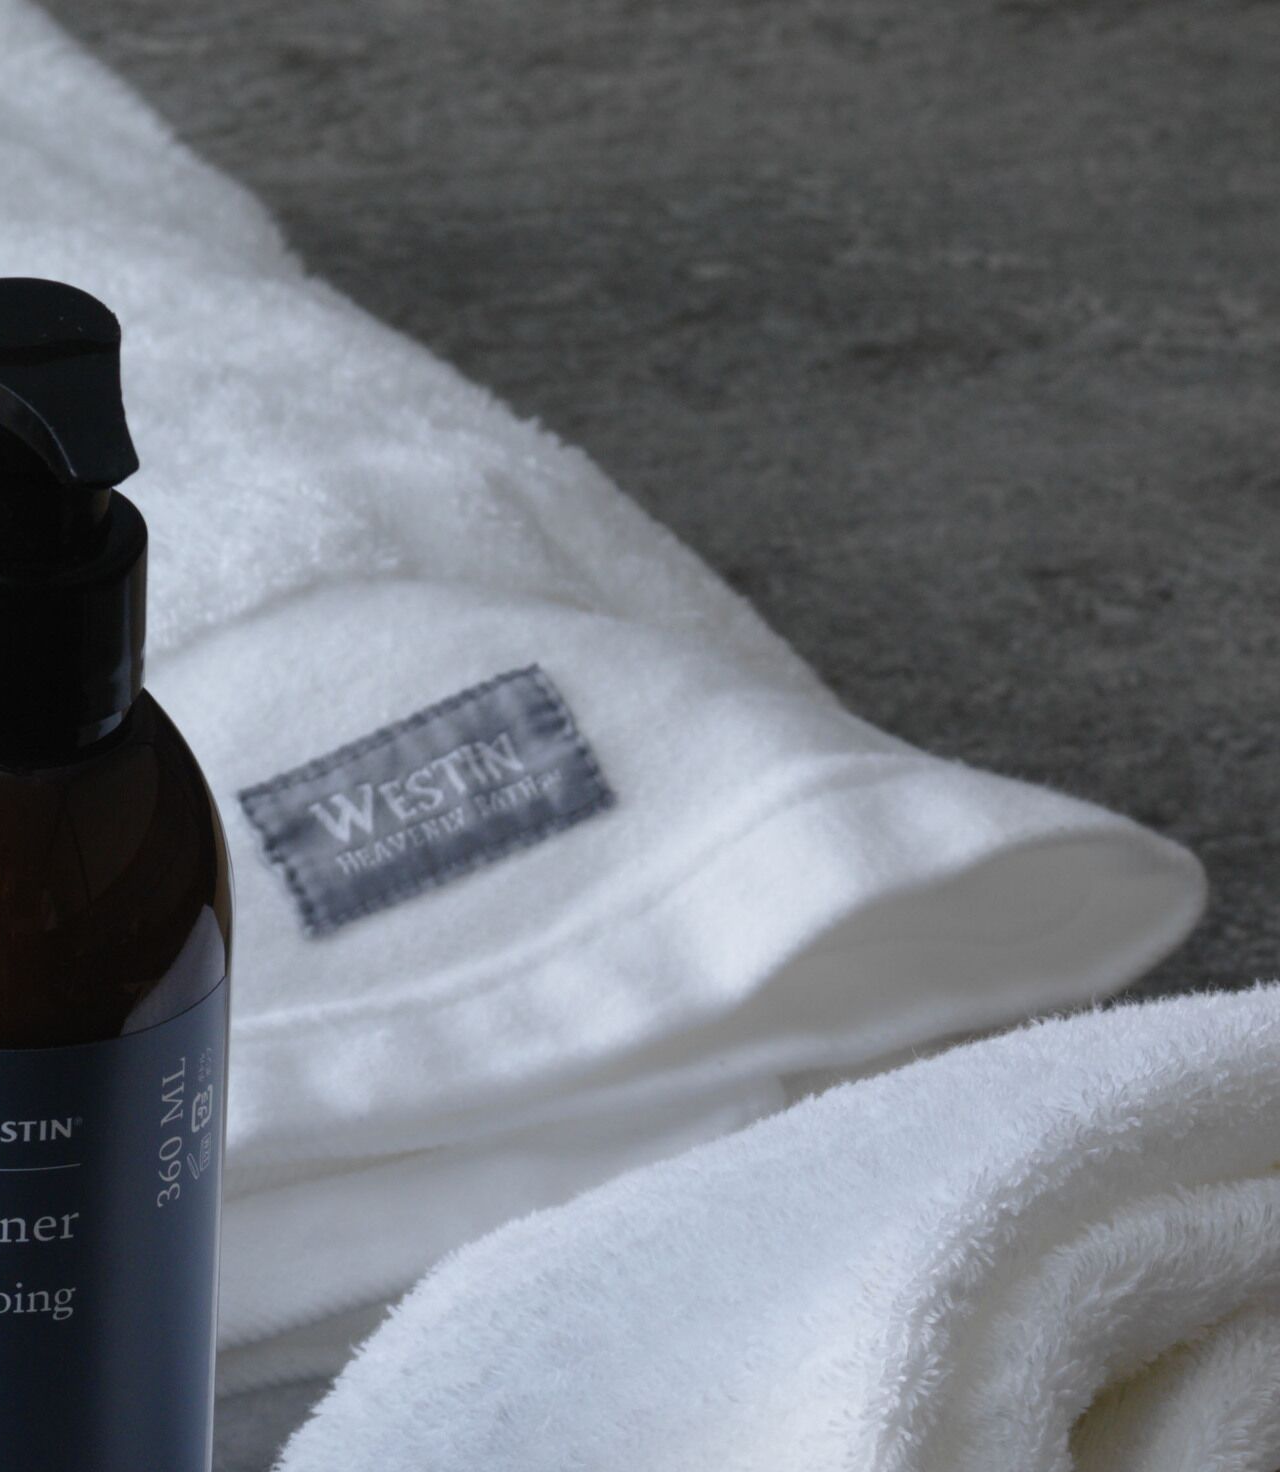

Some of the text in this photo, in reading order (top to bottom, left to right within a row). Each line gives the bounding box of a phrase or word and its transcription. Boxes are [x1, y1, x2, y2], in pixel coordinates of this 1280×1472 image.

[310, 733, 524, 843] WESTIN
[337, 806, 465, 875] HEAVENLY
[157, 1056, 186, 1208] 360 ML
